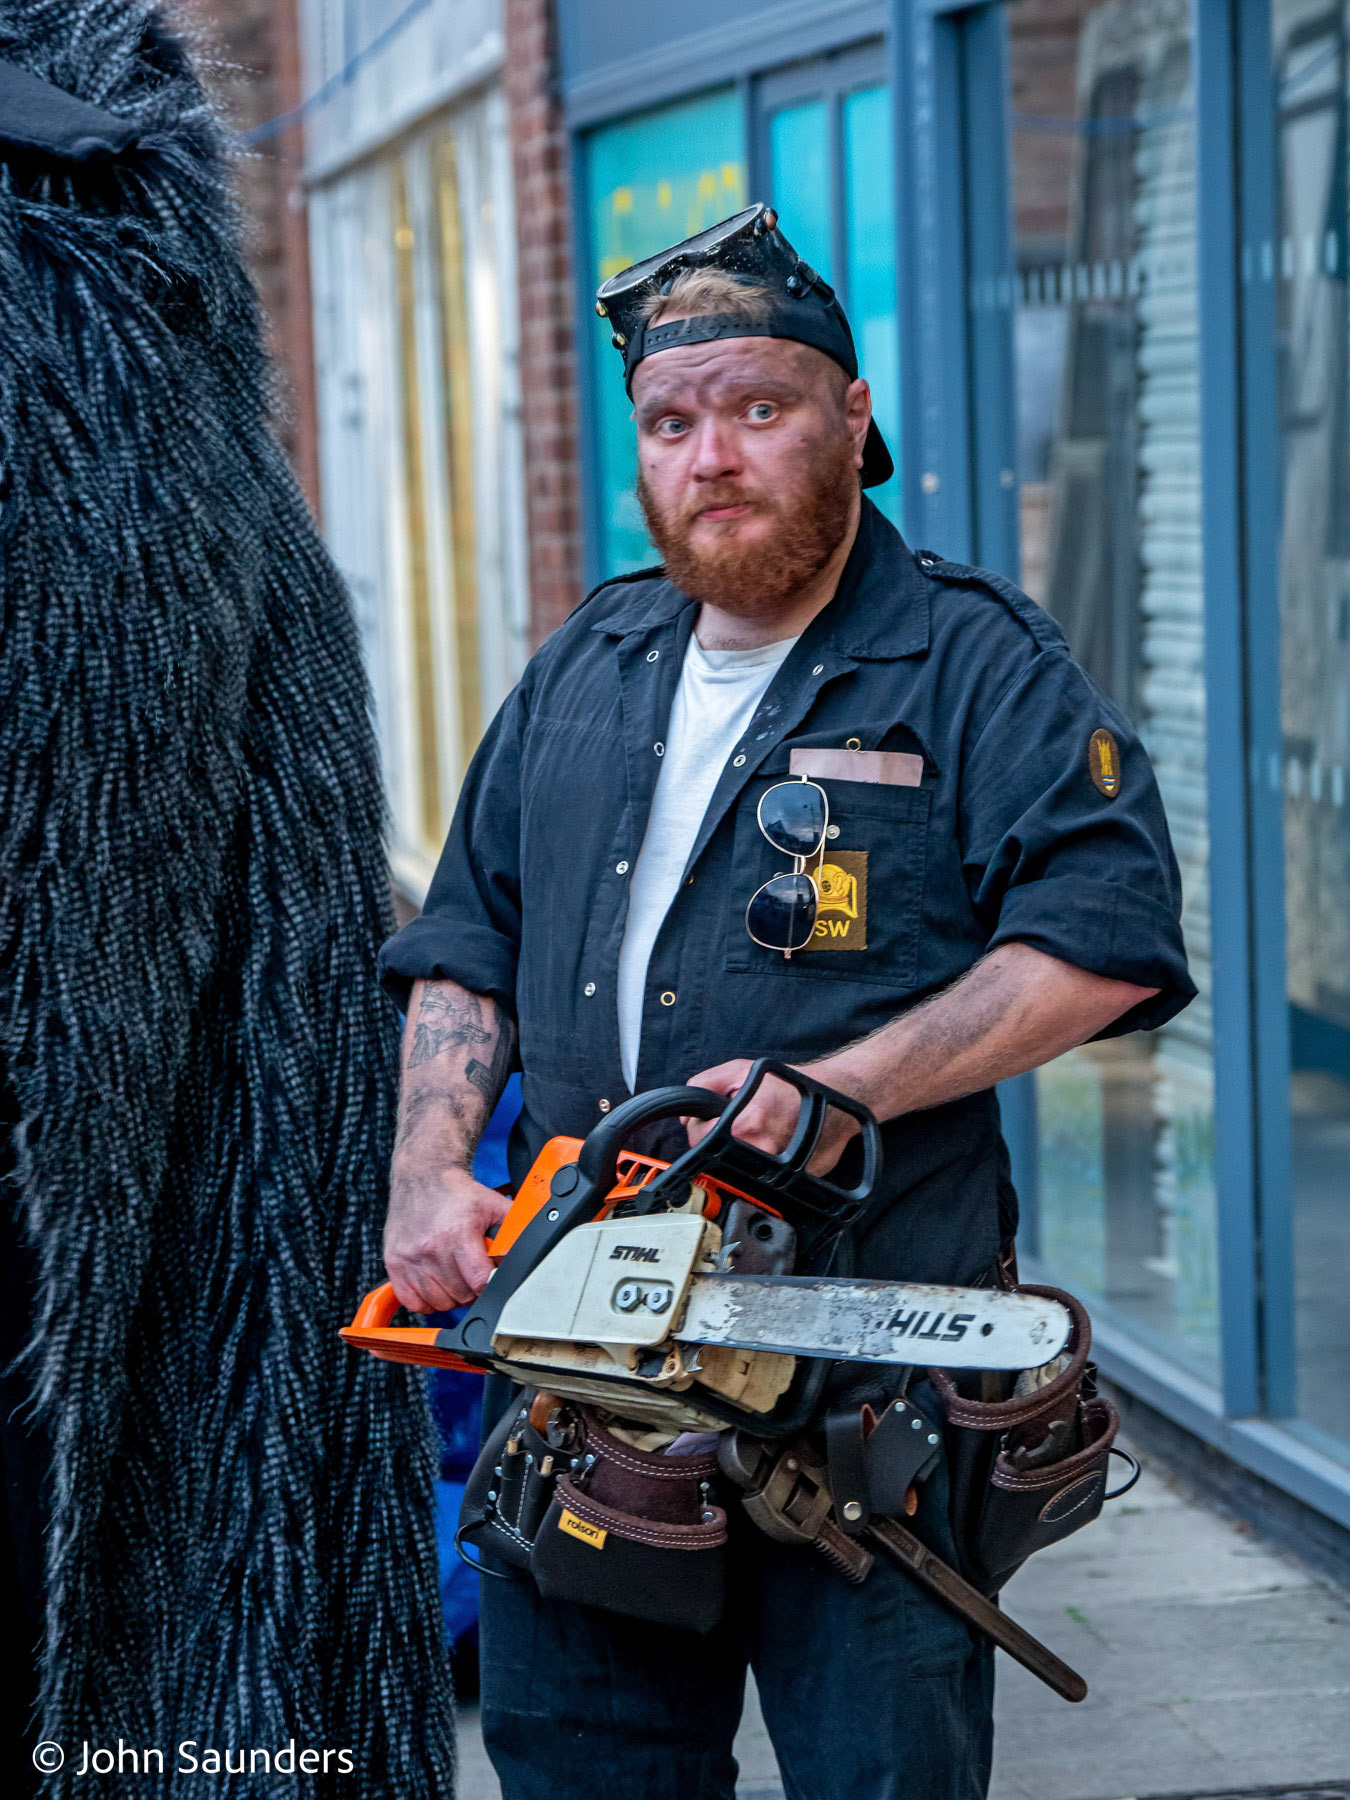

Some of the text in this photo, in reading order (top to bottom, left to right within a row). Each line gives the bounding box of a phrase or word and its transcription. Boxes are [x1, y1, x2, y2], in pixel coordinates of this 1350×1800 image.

[815, 920, 850, 938] SW
[609, 1245, 660, 1263] STIHL
[876, 1308, 977, 1342] STIH
[567, 1519, 599, 1539] rolson
